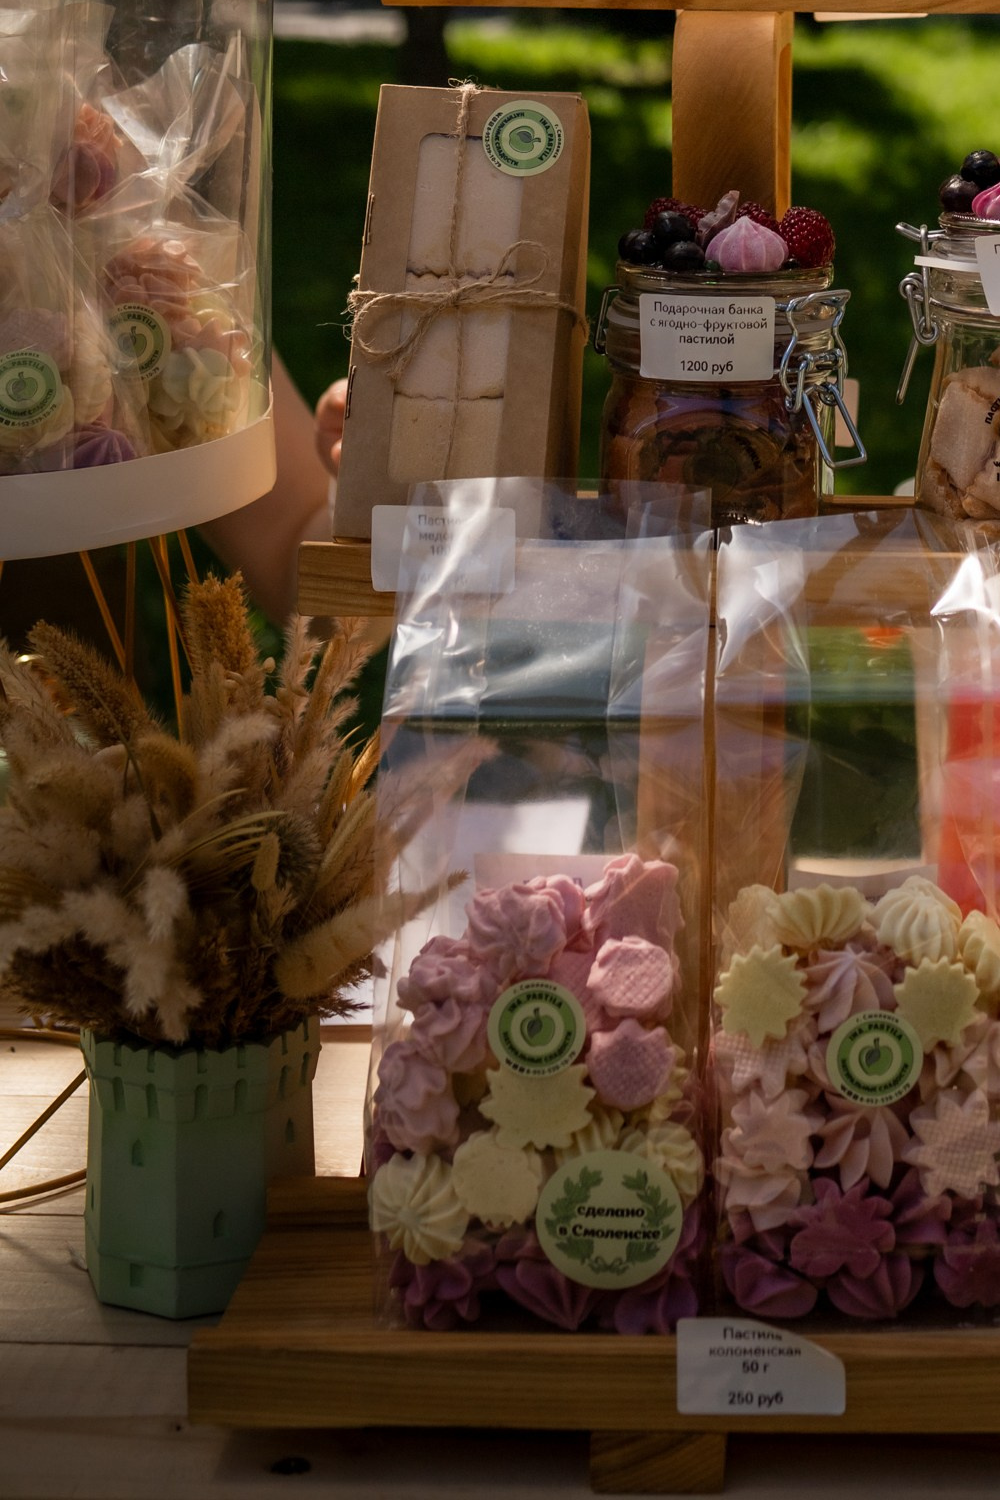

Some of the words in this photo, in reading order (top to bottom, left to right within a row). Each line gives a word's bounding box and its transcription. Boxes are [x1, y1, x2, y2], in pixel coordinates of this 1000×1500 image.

[654, 301, 725, 316] Подарочная
[728, 303, 764, 315] банка
[650, 318, 656, 327] с
[658, 318, 768, 332] ягодно-фруктовой
[679, 333, 735, 344] пастилой
[680, 361, 708, 372] 1200
[711, 361, 734, 375] руб
[577, 1205, 645, 1218] сделано
[558, 1225, 568, 1236] в
[572, 1224, 661, 1240] Смоленске
[709, 1346, 802, 1358] коломенская
[742, 1361, 759, 1374] 50
[763, 1363, 770, 1373] г
[728, 1391, 754, 1406] 250
[758, 1391, 784, 1408] руб
